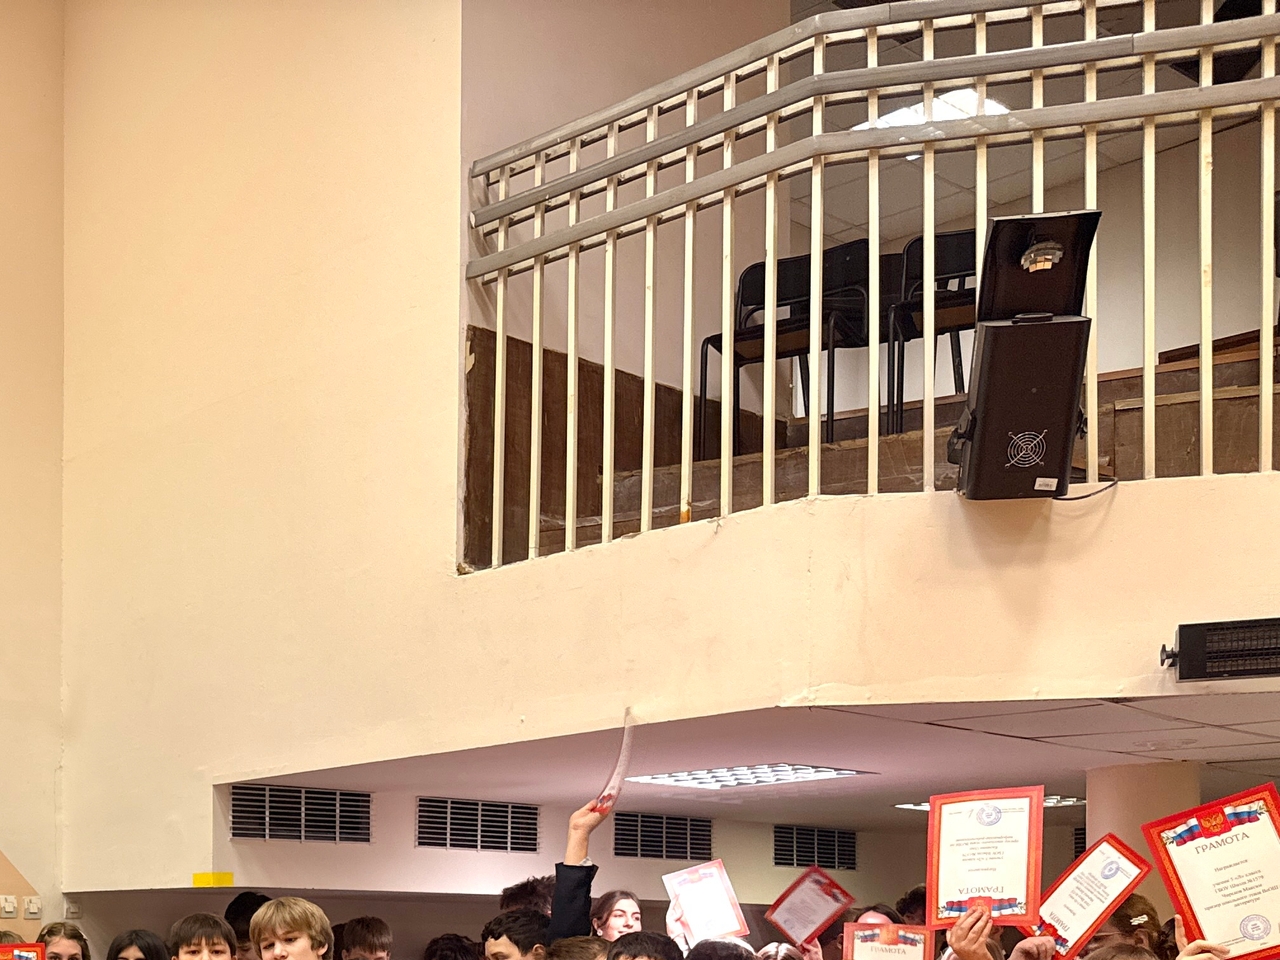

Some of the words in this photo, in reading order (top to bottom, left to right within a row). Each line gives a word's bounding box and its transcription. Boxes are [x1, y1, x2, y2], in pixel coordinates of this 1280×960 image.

[1195, 832, 1250, 854] ГРАМОТА
[958, 885, 1004, 895] ГРАМОТА
[1048, 911, 1070, 932] ГРАМОТА
[870, 946, 907, 955] ГРАМОТА
